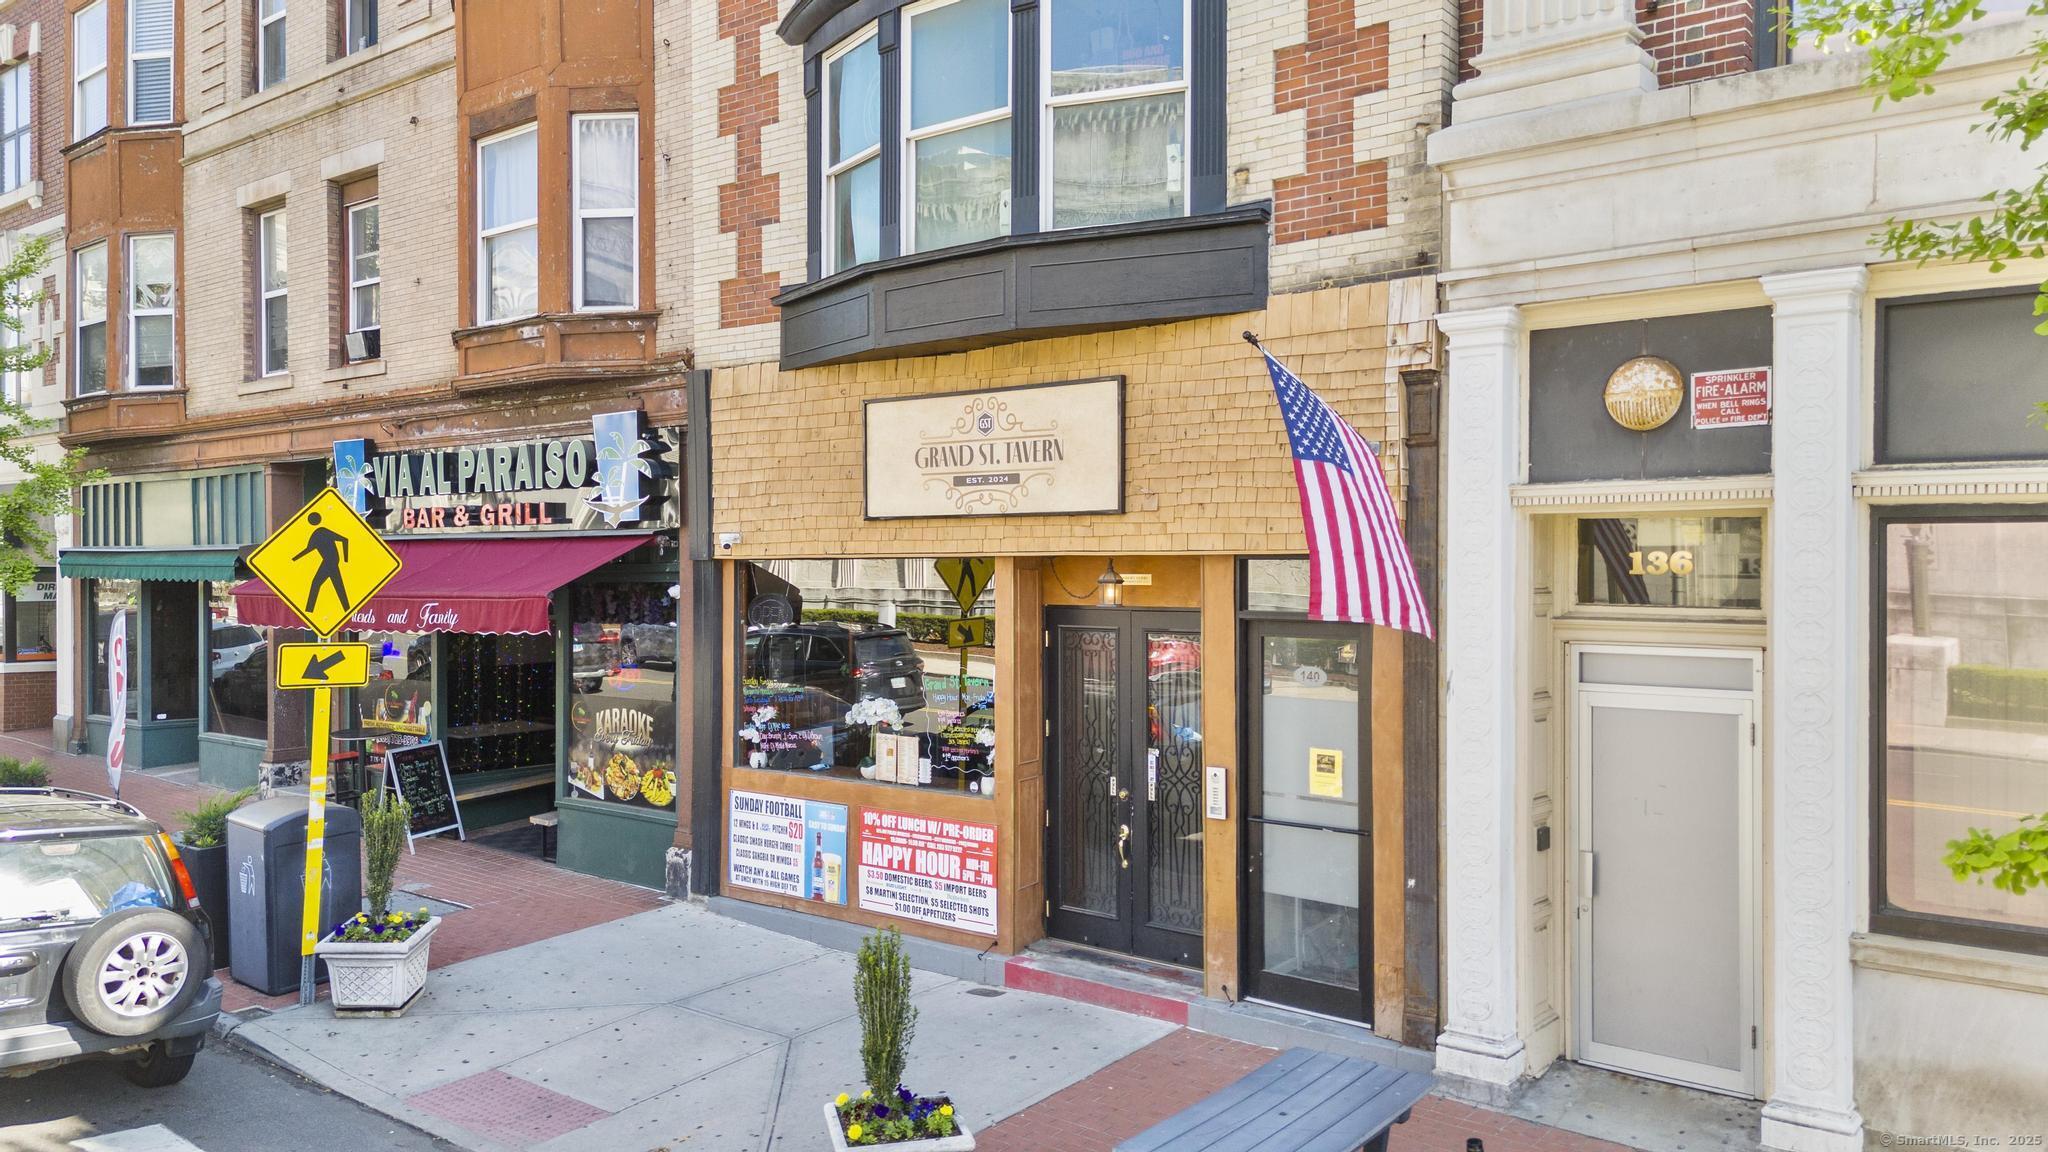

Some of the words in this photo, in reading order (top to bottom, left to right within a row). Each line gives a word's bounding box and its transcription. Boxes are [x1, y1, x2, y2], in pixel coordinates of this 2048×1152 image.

[1705, 372, 1756, 384] SPRINKLER
[1695, 381, 1766, 398] FIRE-ALARM
[1696, 402, 1717, 410] WHEN
[1720, 400, 1739, 408] BELL
[1741, 398, 1766, 406] RINGS
[1720, 408, 1741, 416] CALL
[979, 418, 992, 429] GST
[1695, 417, 1720, 425] POLICE
[914, 444, 974, 469] GRAND
[978, 443, 1001, 466] ST.
[1006, 437, 1065, 464] TAVERN
[372, 453, 414, 498] VIA
[420, 451, 451, 496] AL
[458, 439, 587, 493] PARAISO
[988, 475, 1009, 483] 2024
[403, 506, 446, 529] BAR
[453, 504, 470, 526] &
[480, 502, 552, 526] GRILL
[1628, 550, 1694, 576] 136
[387, 609, 409, 624] and
[1299, 671, 1321, 682] 140
[595, 708, 654, 740] KARAOKE
[593, 727, 619, 749] Every
[621, 729, 655, 748] Friday
[734, 795, 764, 813] SUNDAY
[765, 800, 802, 819] FOOTBALL
[739, 819, 752, 830] WINGS
[772, 824, 788, 835] PITCHER
[788, 821, 803, 840] $20
[863, 812, 881, 827] 10%
[881, 814, 897, 829] OFF
[897, 815, 927, 833] LUNCH
[927, 820, 942, 836] W/
[942, 823, 994, 843] PRE-ORDER
[733, 833, 749, 844] CLASSIC
[749, 836, 763, 847] SMASH
[764, 838, 779, 849] BURGER
[779, 841, 793, 852] COMBO
[735, 848, 752, 859] CLASSIC
[752, 850, 769, 861] SANGRIA
[770, 854, 775, 863] OR
[776, 855, 792, 866] MIMOSA
[862, 841, 913, 872] HAPPY
[915, 849, 961, 880] HOUR
[966, 858, 990, 873] MON-FRI
[733, 864, 753, 875] WATCH
[753, 867, 765, 877] ANY
[770, 870, 780, 880] ALL
[780, 872, 800, 883] GAMES
[741, 875, 752, 883] ONCE
[752, 877, 763, 885] WITH
[764, 879, 769, 887] 15
[770, 880, 781, 889] HIGH
[962, 869, 976, 882] 5PM
[867, 869, 884, 880] $3.50
[884, 872, 914, 885] DOMESTIC
[935, 881, 943, 891] $5
[944, 883, 968, 895] IMPORT
[968, 887, 988, 899] BEERS
[866, 886, 874, 895] $8
[874, 887, 898, 900] MARTINI
[931, 898, 939, 908] $5
[940, 899, 969, 913] SELECTED
[969, 905, 991, 918] SHOTS
[894, 902, 911, 913] $1.00
[912, 906, 922, 916] OFF
[923, 908, 957, 922] APPETIZERS
